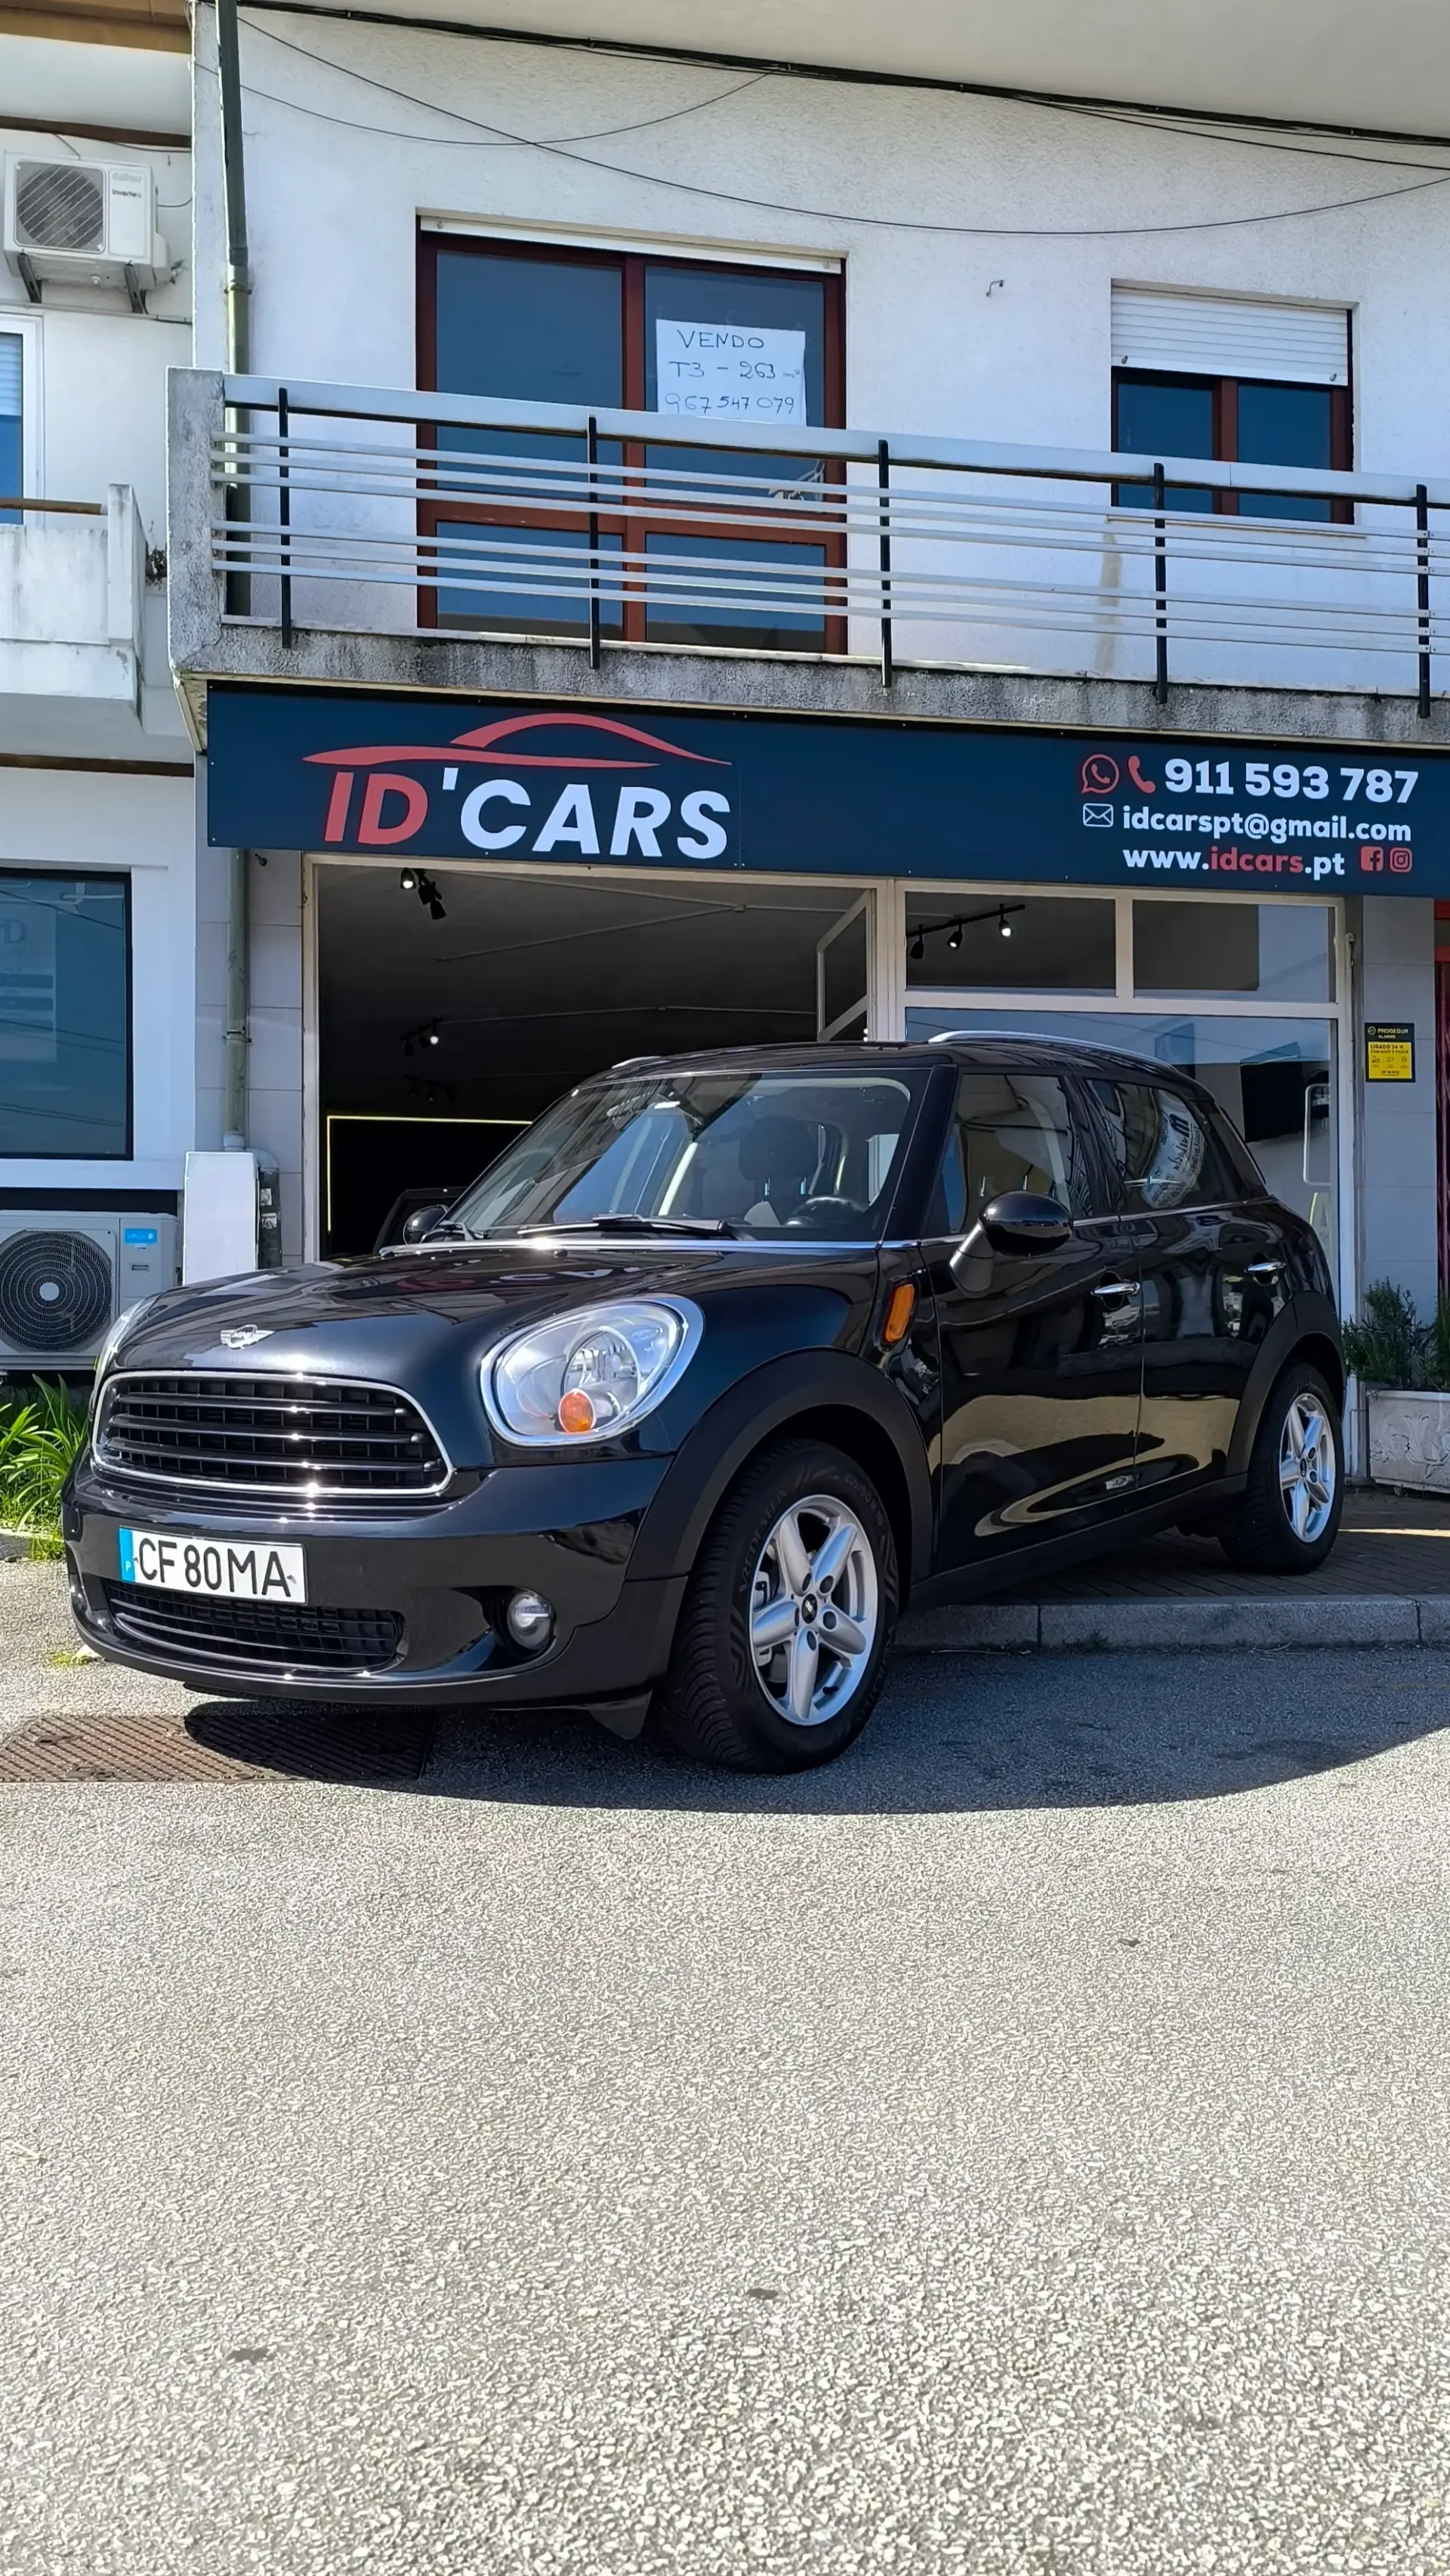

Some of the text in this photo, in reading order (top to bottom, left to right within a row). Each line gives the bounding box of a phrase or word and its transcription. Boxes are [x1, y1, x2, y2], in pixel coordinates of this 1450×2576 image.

[677, 329, 764, 349] VENDO
[668, 361, 705, 378] T3
[739, 361, 776, 379] 263
[1165, 757, 1419, 804] 911 593 787
[1122, 805, 1412, 844] idcarspt@gmail.com
[1122, 846, 1346, 881] www.idcars.pt
[125, 1560, 131, 1572] P
